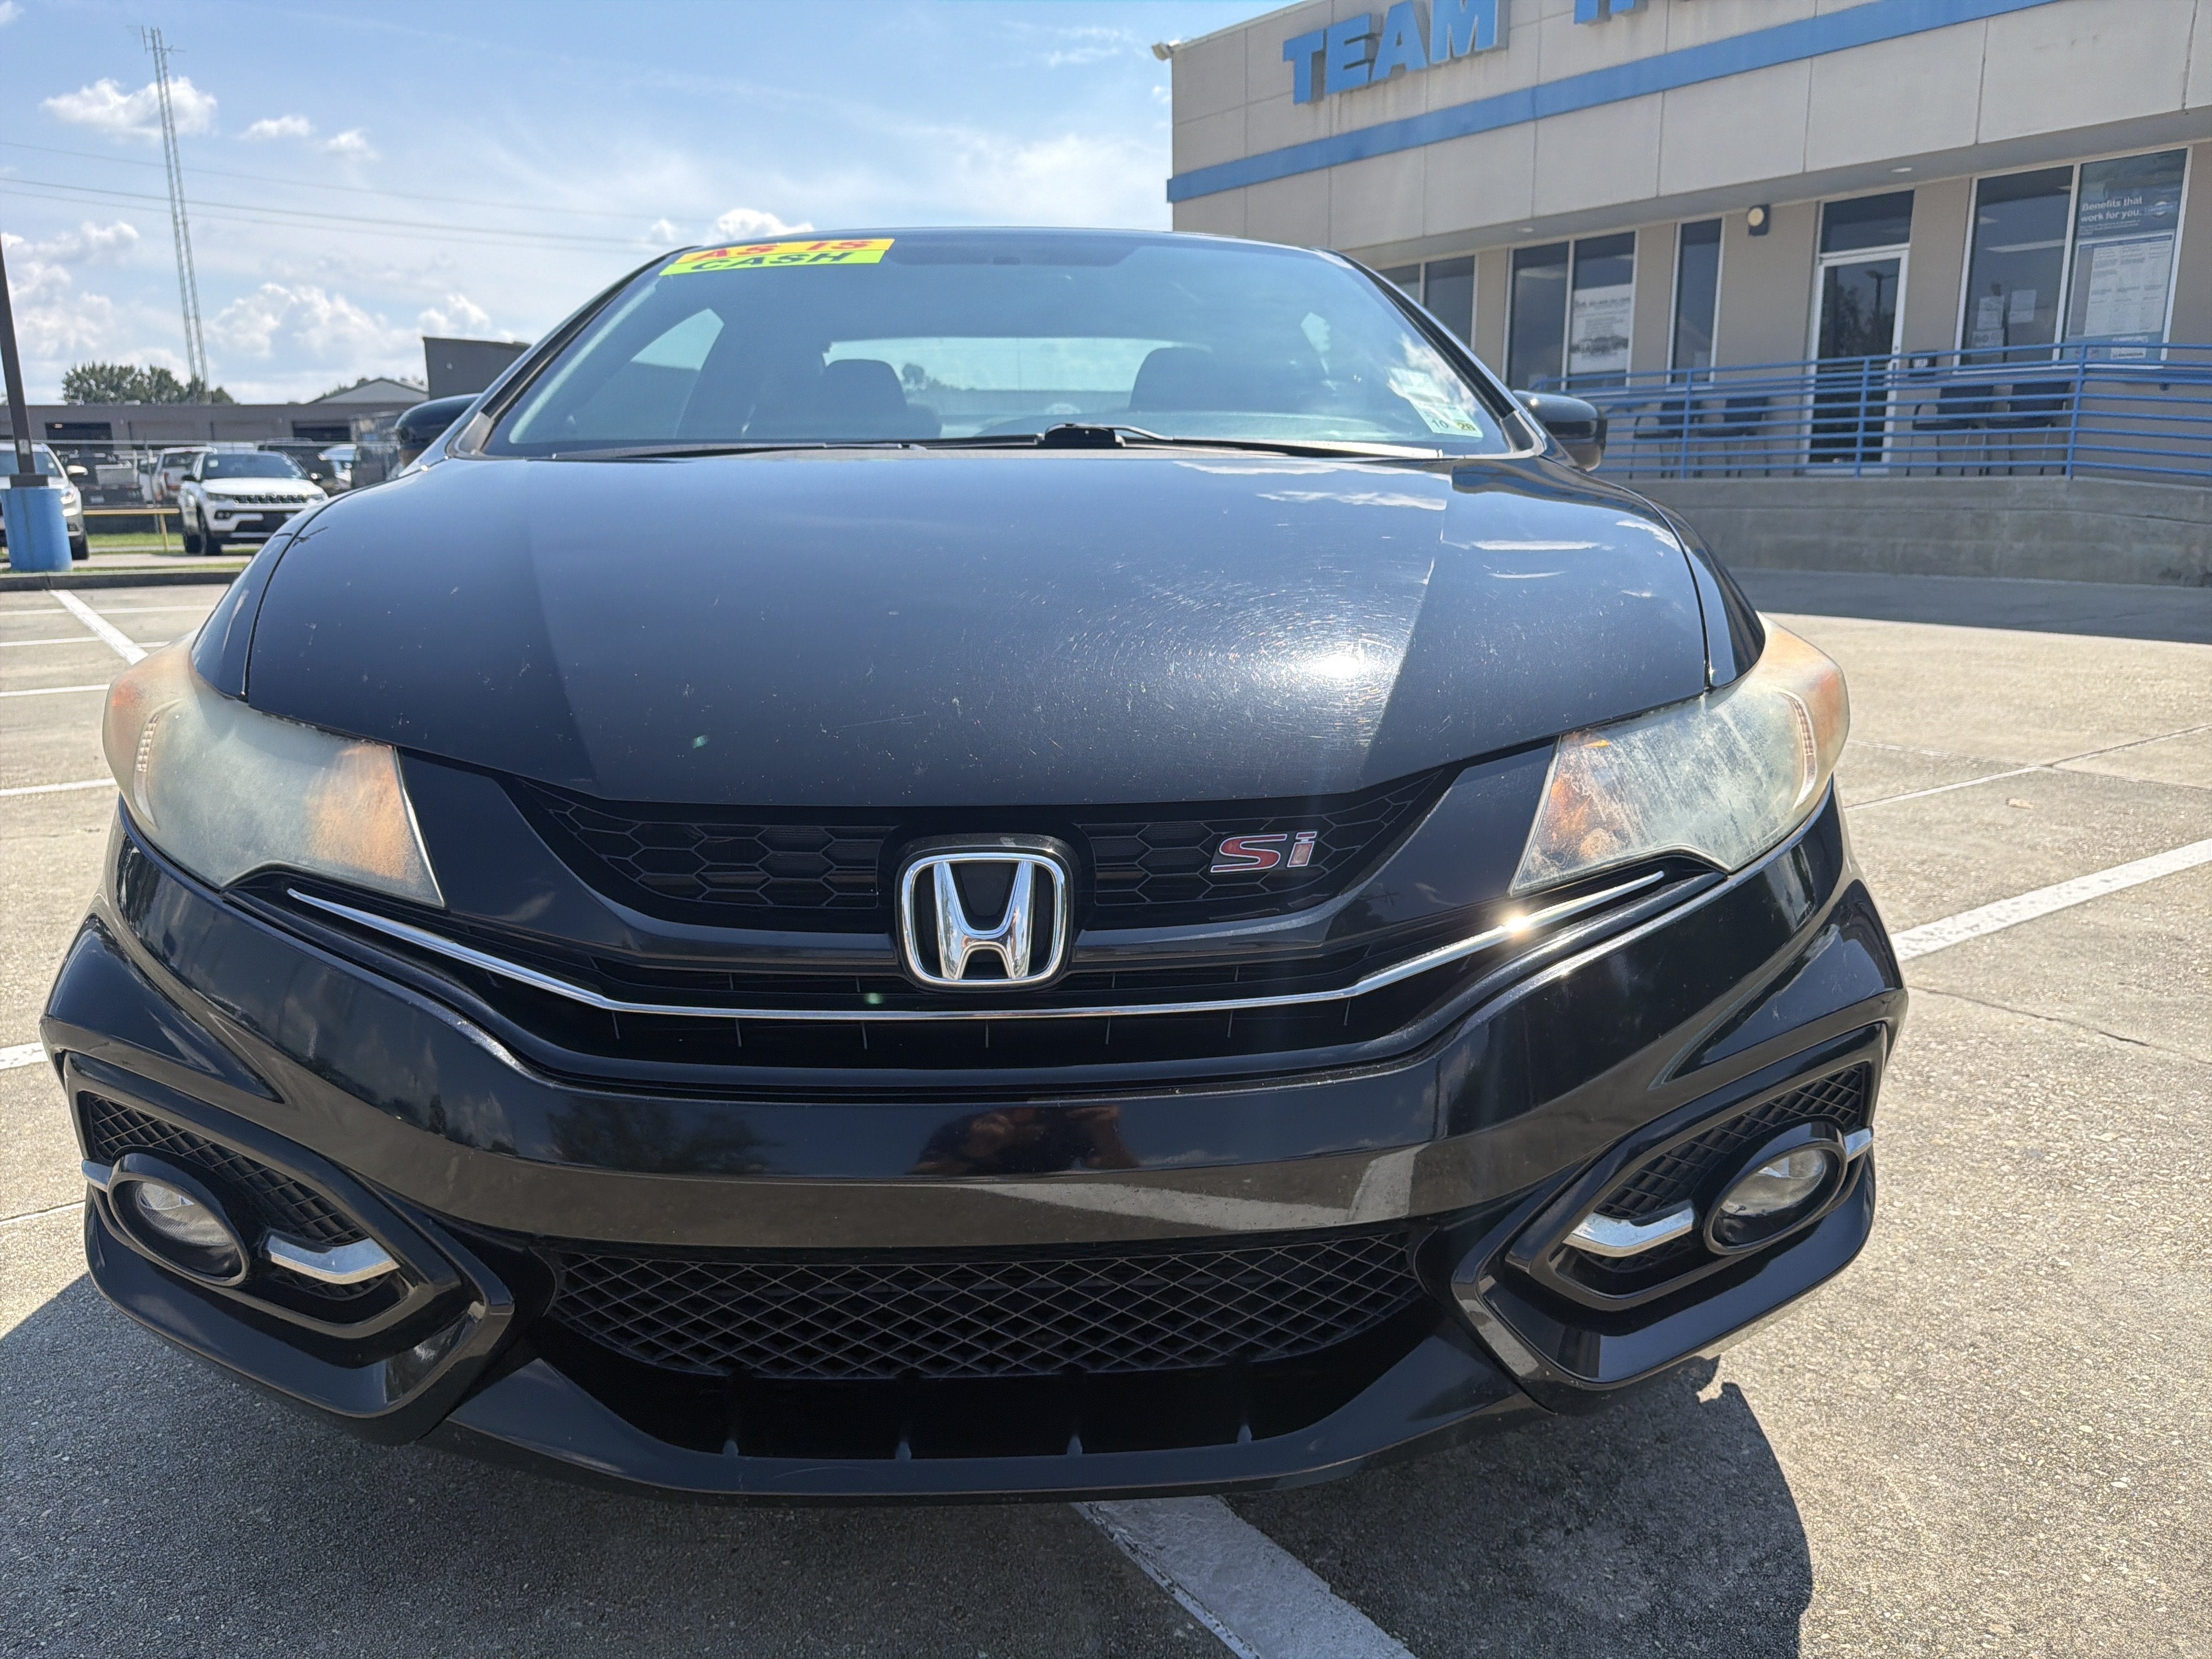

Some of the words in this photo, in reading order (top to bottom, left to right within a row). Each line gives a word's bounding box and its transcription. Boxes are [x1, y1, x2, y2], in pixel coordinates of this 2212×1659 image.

[1283, 0, 1499, 104] TEAM
[2081, 199, 2121, 211] Benefits
[2124, 196, 2142, 206] that
[2081, 212, 2103, 222] work
[2106, 211, 2119, 219] for
[693, 245, 777, 261] AS
[805, 241, 874, 251] IS
[691, 252, 855, 269] CASH
[1432, 420, 1448, 428] 10
[1210, 831, 1317, 873] Si
